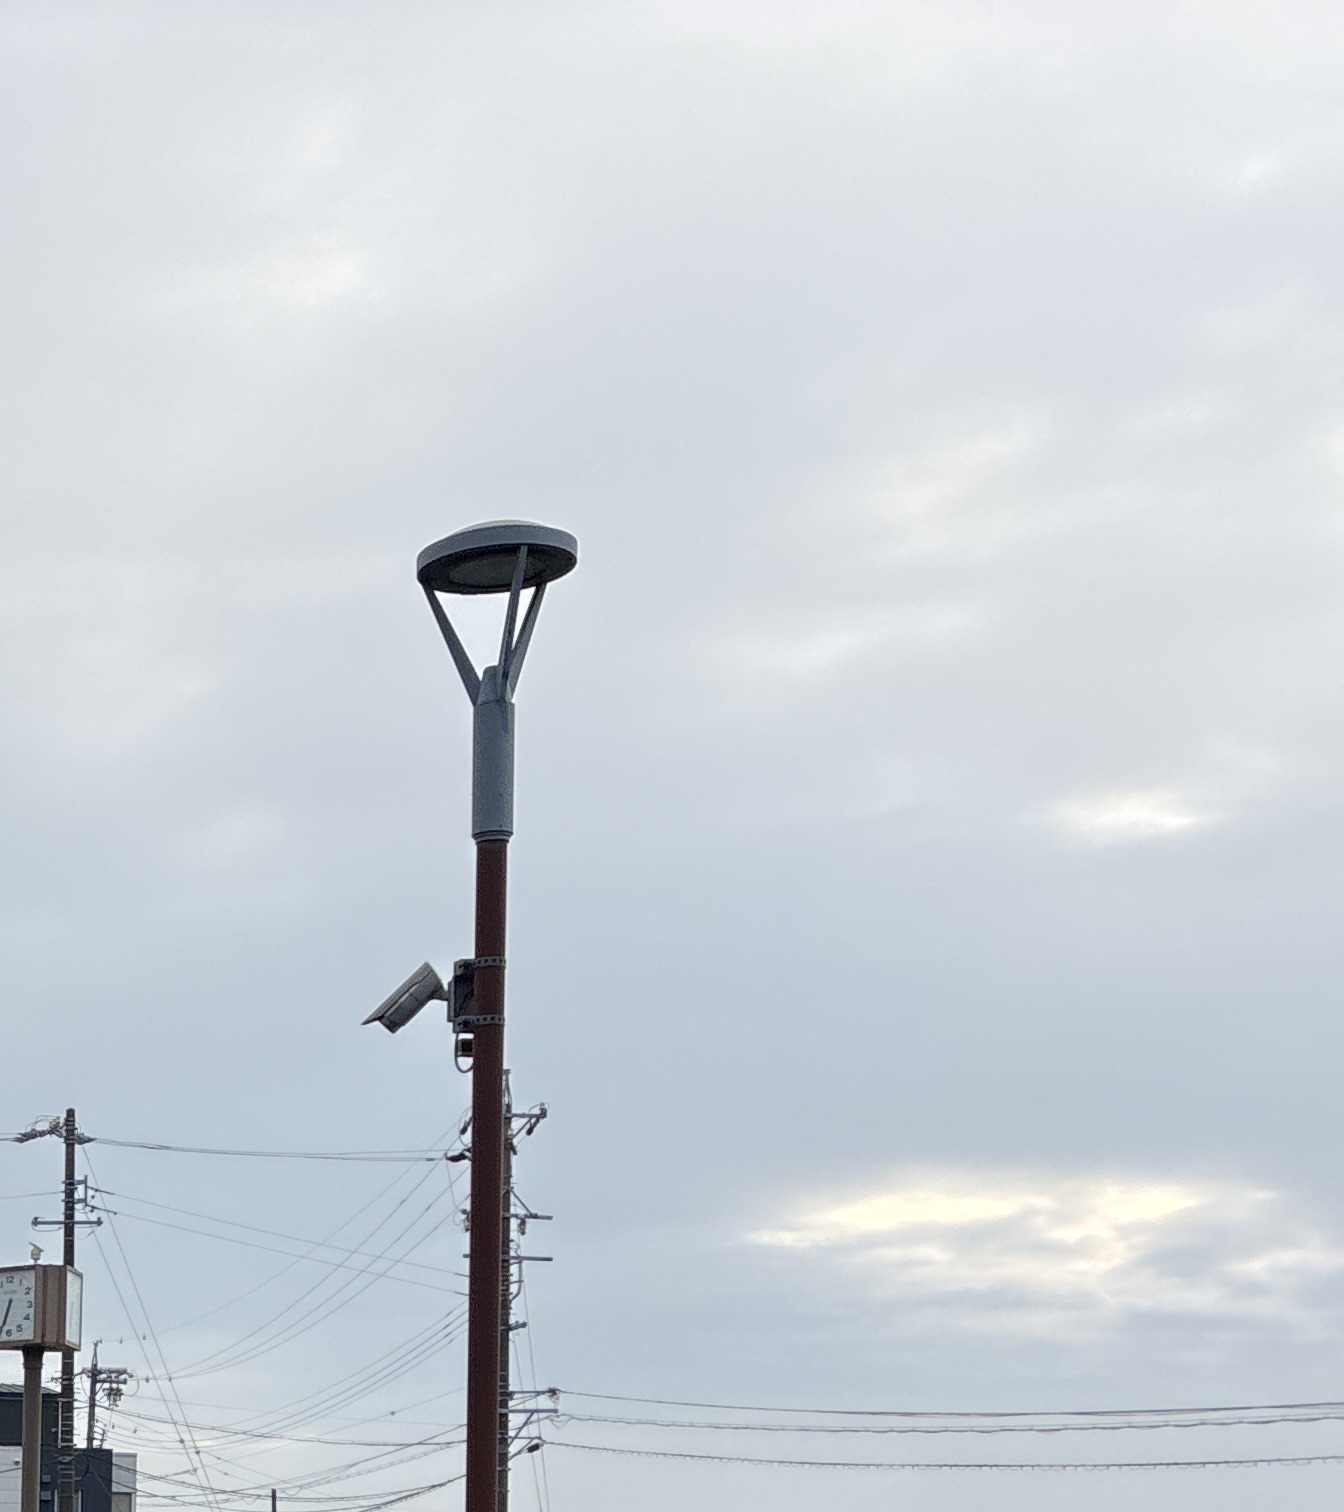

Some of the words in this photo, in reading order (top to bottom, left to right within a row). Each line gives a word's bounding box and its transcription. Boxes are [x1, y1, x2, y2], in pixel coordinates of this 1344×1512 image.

[5, 1275, 15, 1284] 12
[24, 1286, 32, 1295] 2
[26, 1300, 33, 1309] 3
[23, 1313, 31, 1321] 4
[5, 1329, 13, 1337] 6
